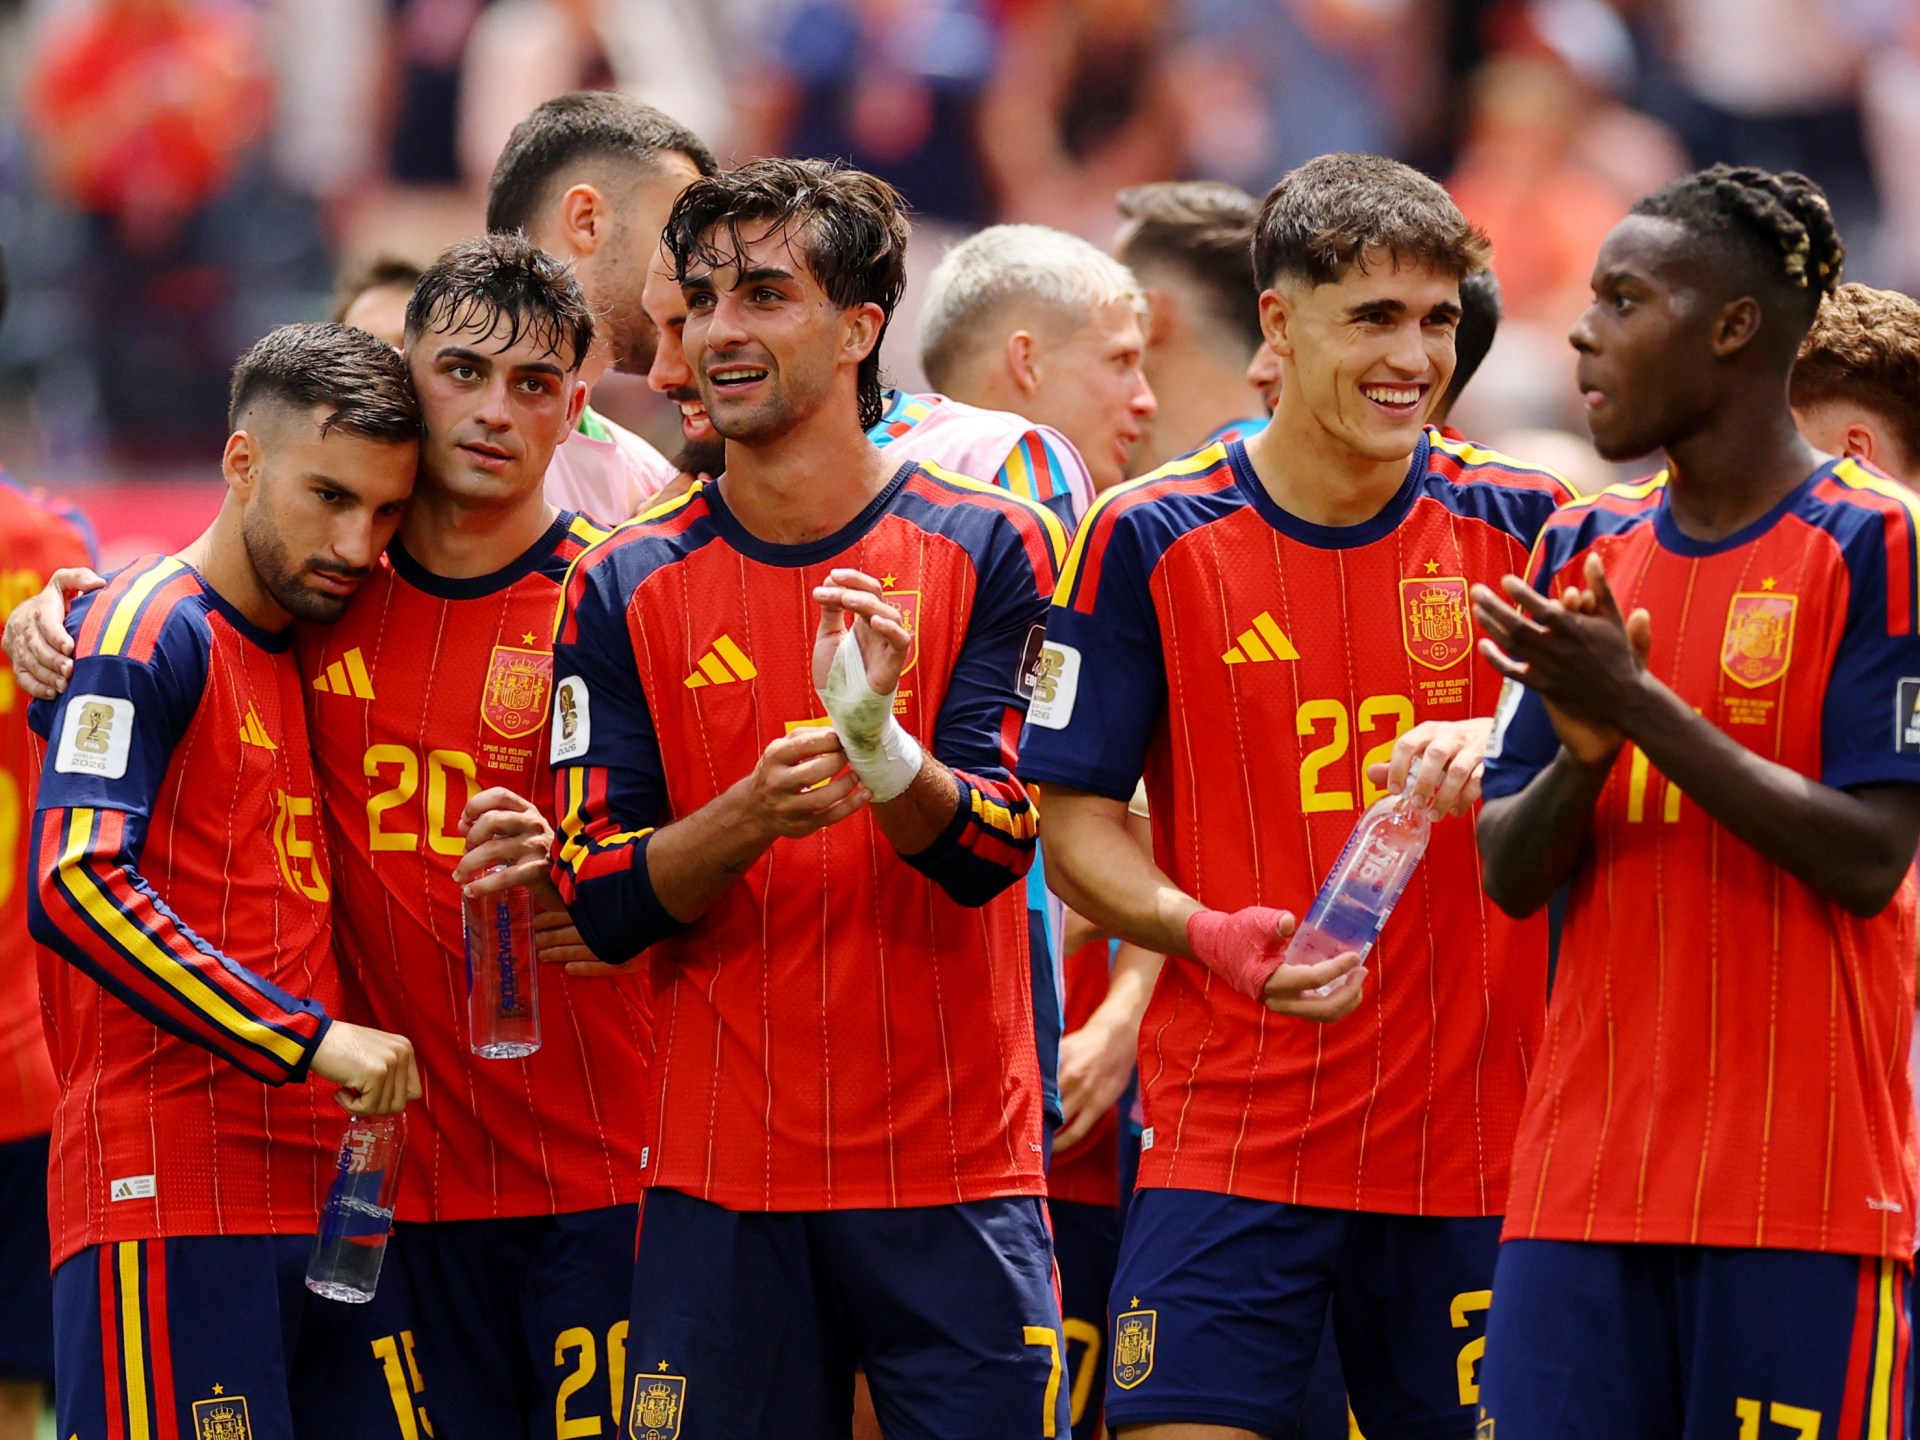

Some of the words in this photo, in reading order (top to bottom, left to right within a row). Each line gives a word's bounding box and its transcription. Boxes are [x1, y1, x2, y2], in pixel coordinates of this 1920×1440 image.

[71, 758, 106, 770] 2026
[363, 744, 482, 856] 20
[1296, 694, 1415, 813] 22
[273, 787, 330, 902] 15
[1022, 1325, 1062, 1438] 7
